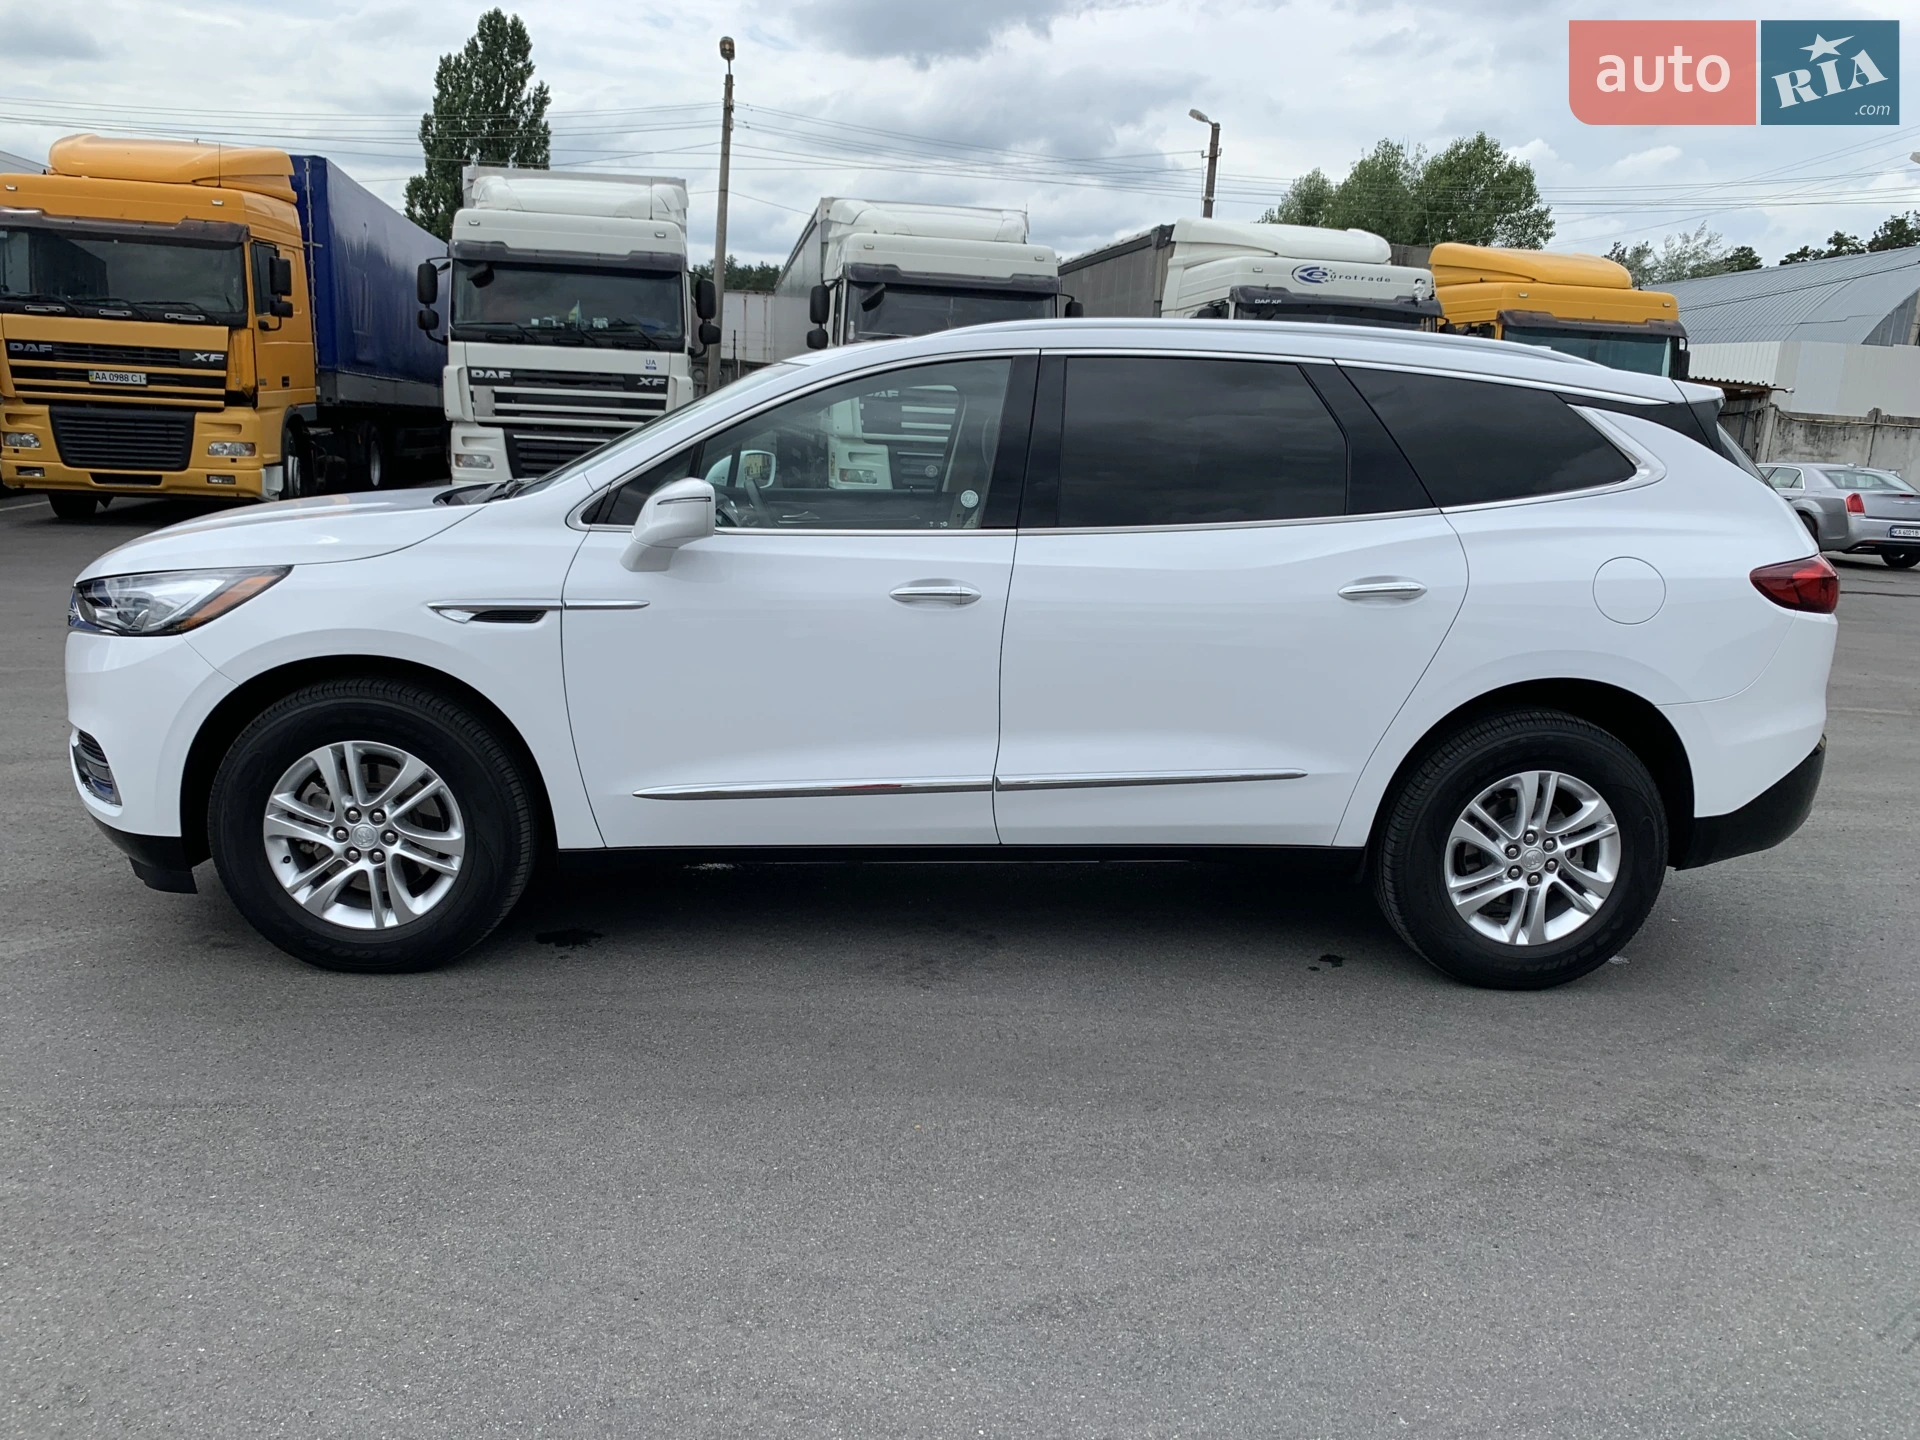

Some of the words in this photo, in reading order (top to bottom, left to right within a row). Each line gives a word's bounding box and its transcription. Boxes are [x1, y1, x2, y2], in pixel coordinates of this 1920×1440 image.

[9, 342, 53, 353] DAF
[192, 352, 225, 362] XF
[94, 372, 107, 381] AA
[108, 373, 130, 383] 0988
[471, 369, 511, 379] DAF
[637, 377, 666, 387] XF
